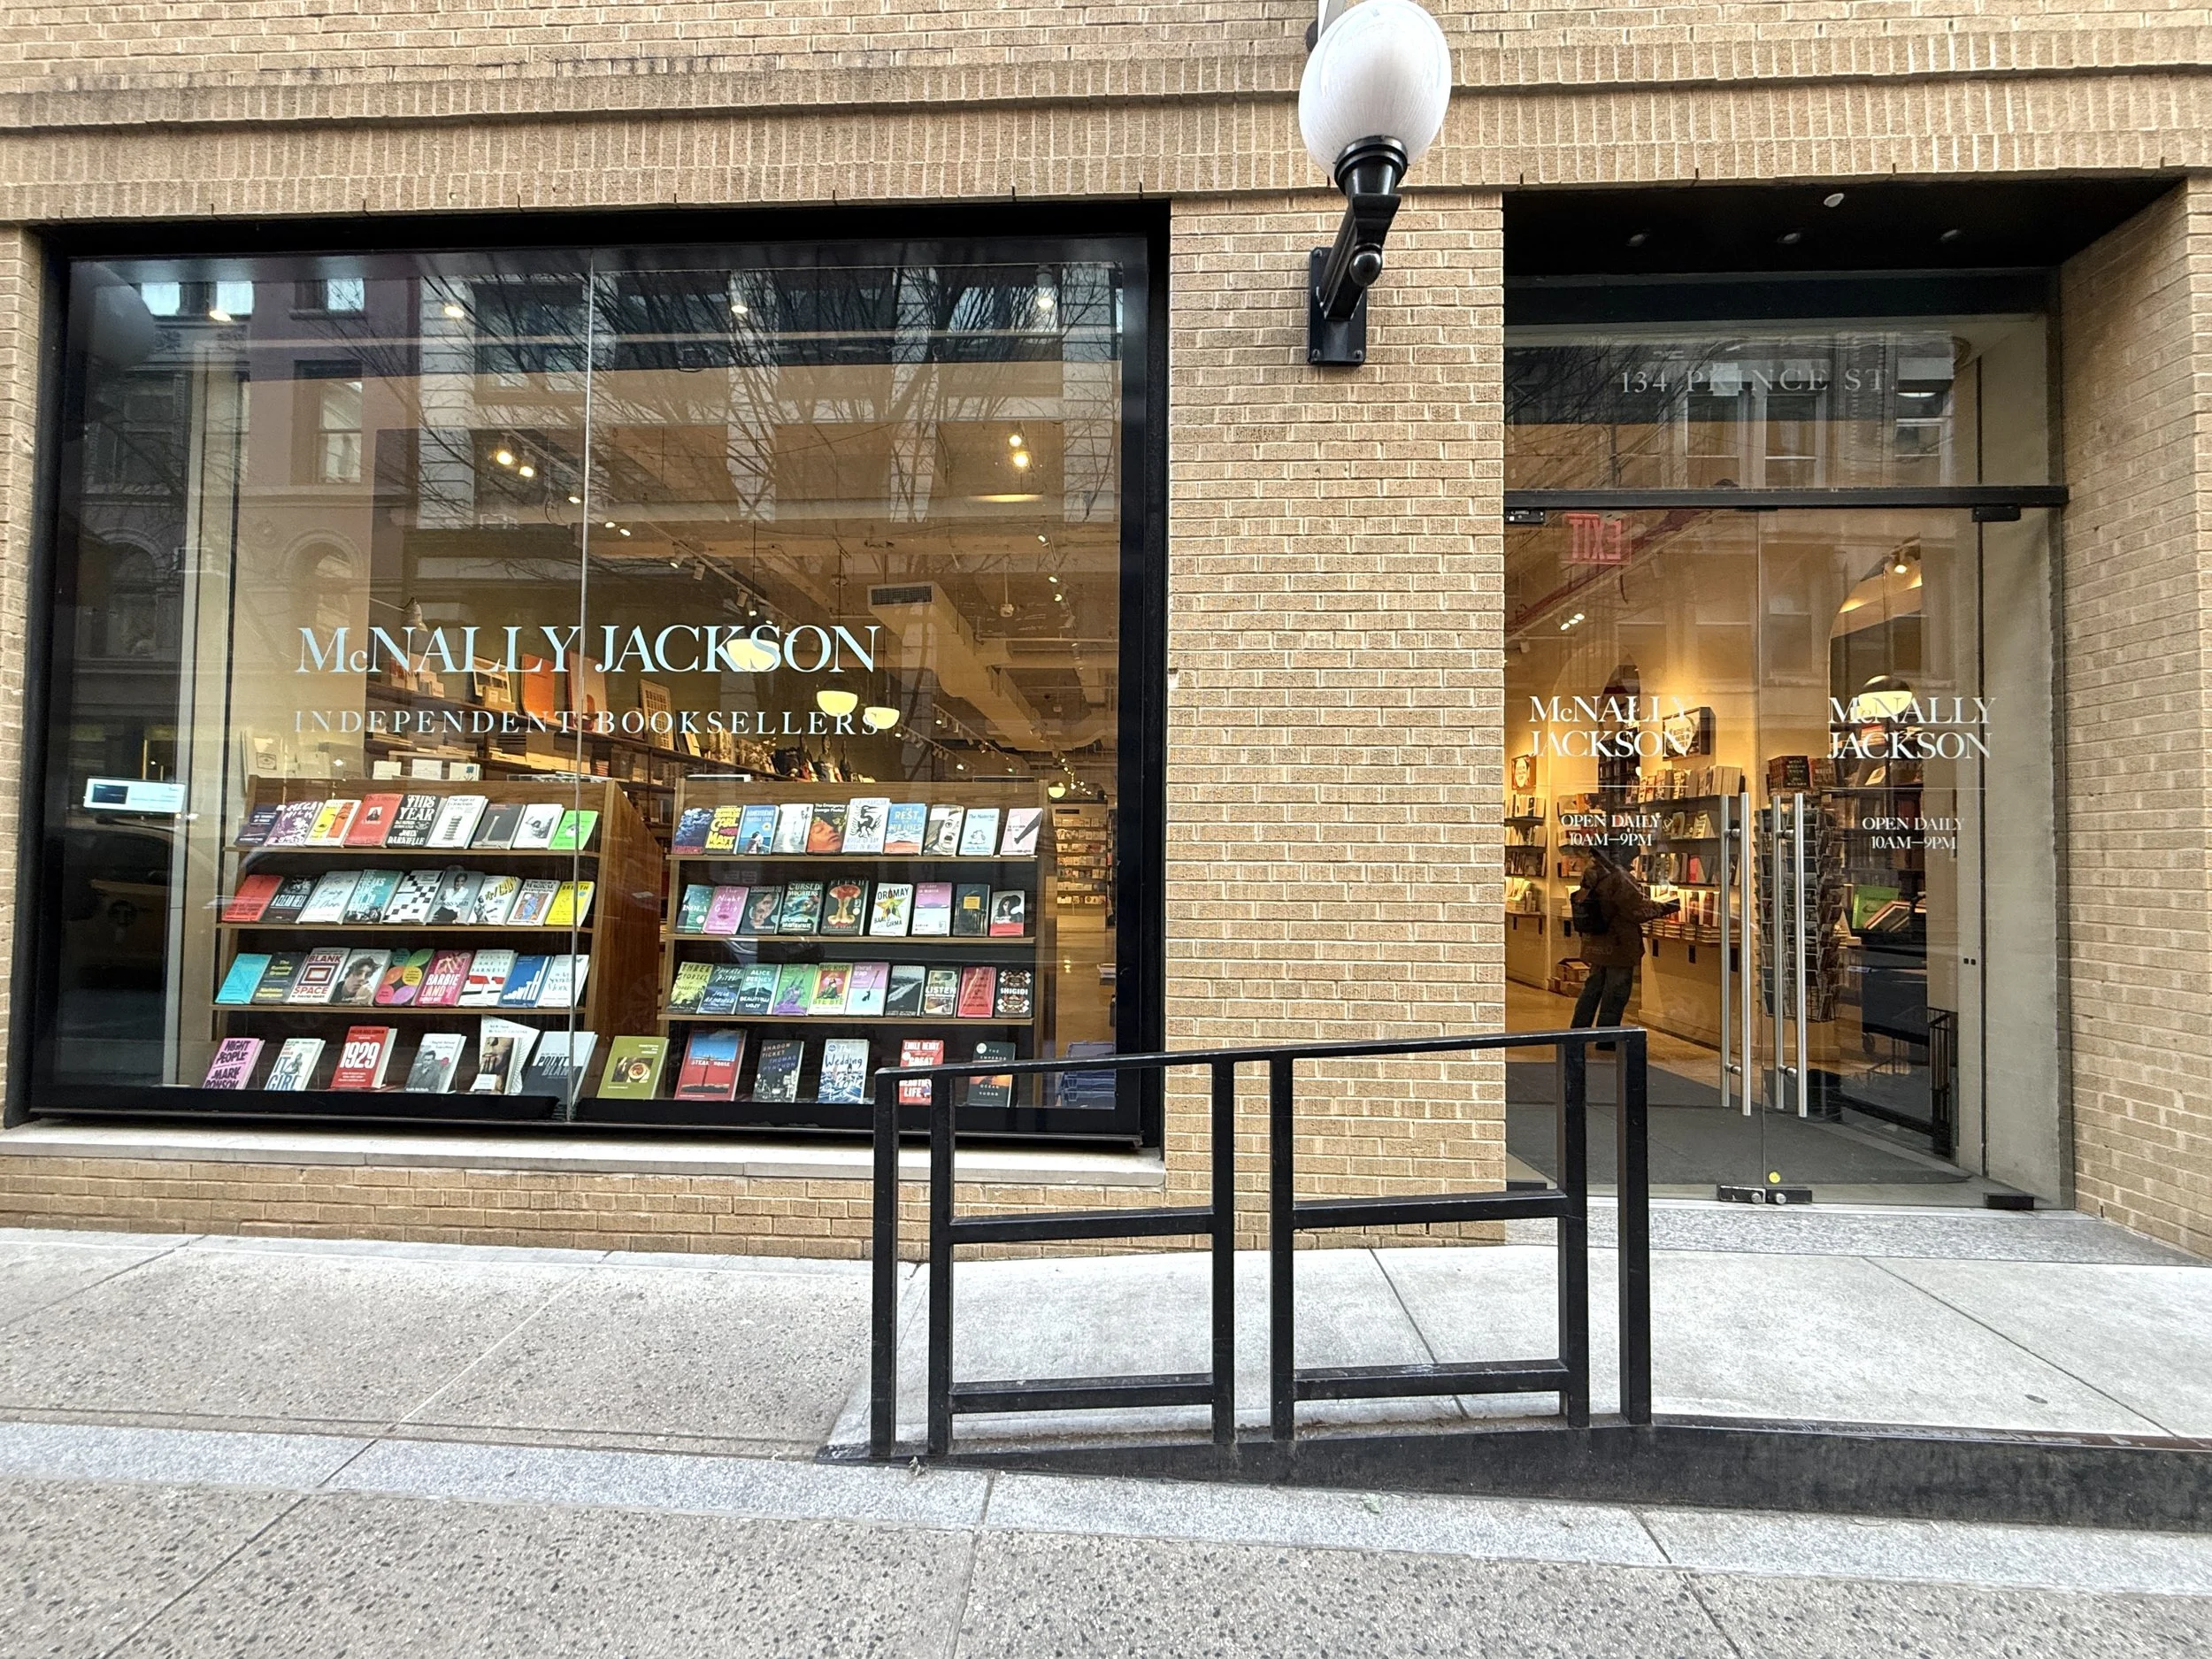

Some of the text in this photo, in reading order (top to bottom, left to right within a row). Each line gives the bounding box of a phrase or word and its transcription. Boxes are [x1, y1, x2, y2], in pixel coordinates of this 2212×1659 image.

[1621, 371, 1668, 393] 134
[1686, 368, 1828, 392] PRINCE
[297, 625, 879, 672] McNALLY JACKSON
[1827, 696, 1997, 724] McNALLY
[296, 710, 879, 735] INDEPENDENT BOOKSELLERS
[1528, 730, 1691, 758] JACKSON
[1827, 732, 1993, 759] JACKSON
[287, 801, 318, 811] MEGA
[407, 795, 436, 808] THIS
[399, 806, 435, 821] YEAR
[895, 810, 918, 819] REST
[1561, 813, 1661, 828] OPEN DAILY
[1862, 817, 1964, 831] OPEN DAILY
[717, 895, 741, 906] Night
[681, 963, 711, 972] THREE
[714, 966, 742, 975] PRIVATE
[426, 973, 461, 986] BARBIE
[421, 985, 445, 996] LAND
[925, 986, 956, 995] LISTEN
[224, 1040, 251, 1052] NIGHT
[763, 1042, 791, 1051] SHADOW
[839, 1044, 851, 1053] The
[216, 1052, 249, 1065] PEOPLE
[339, 1041, 381, 1069] 1929
[537, 1056, 571, 1066] POINT
[825, 1054, 863, 1069] Wedding
[273, 1056, 291, 1073] IT
[211, 1066, 242, 1079] MARK
[903, 1087, 922, 1097] LIFE
